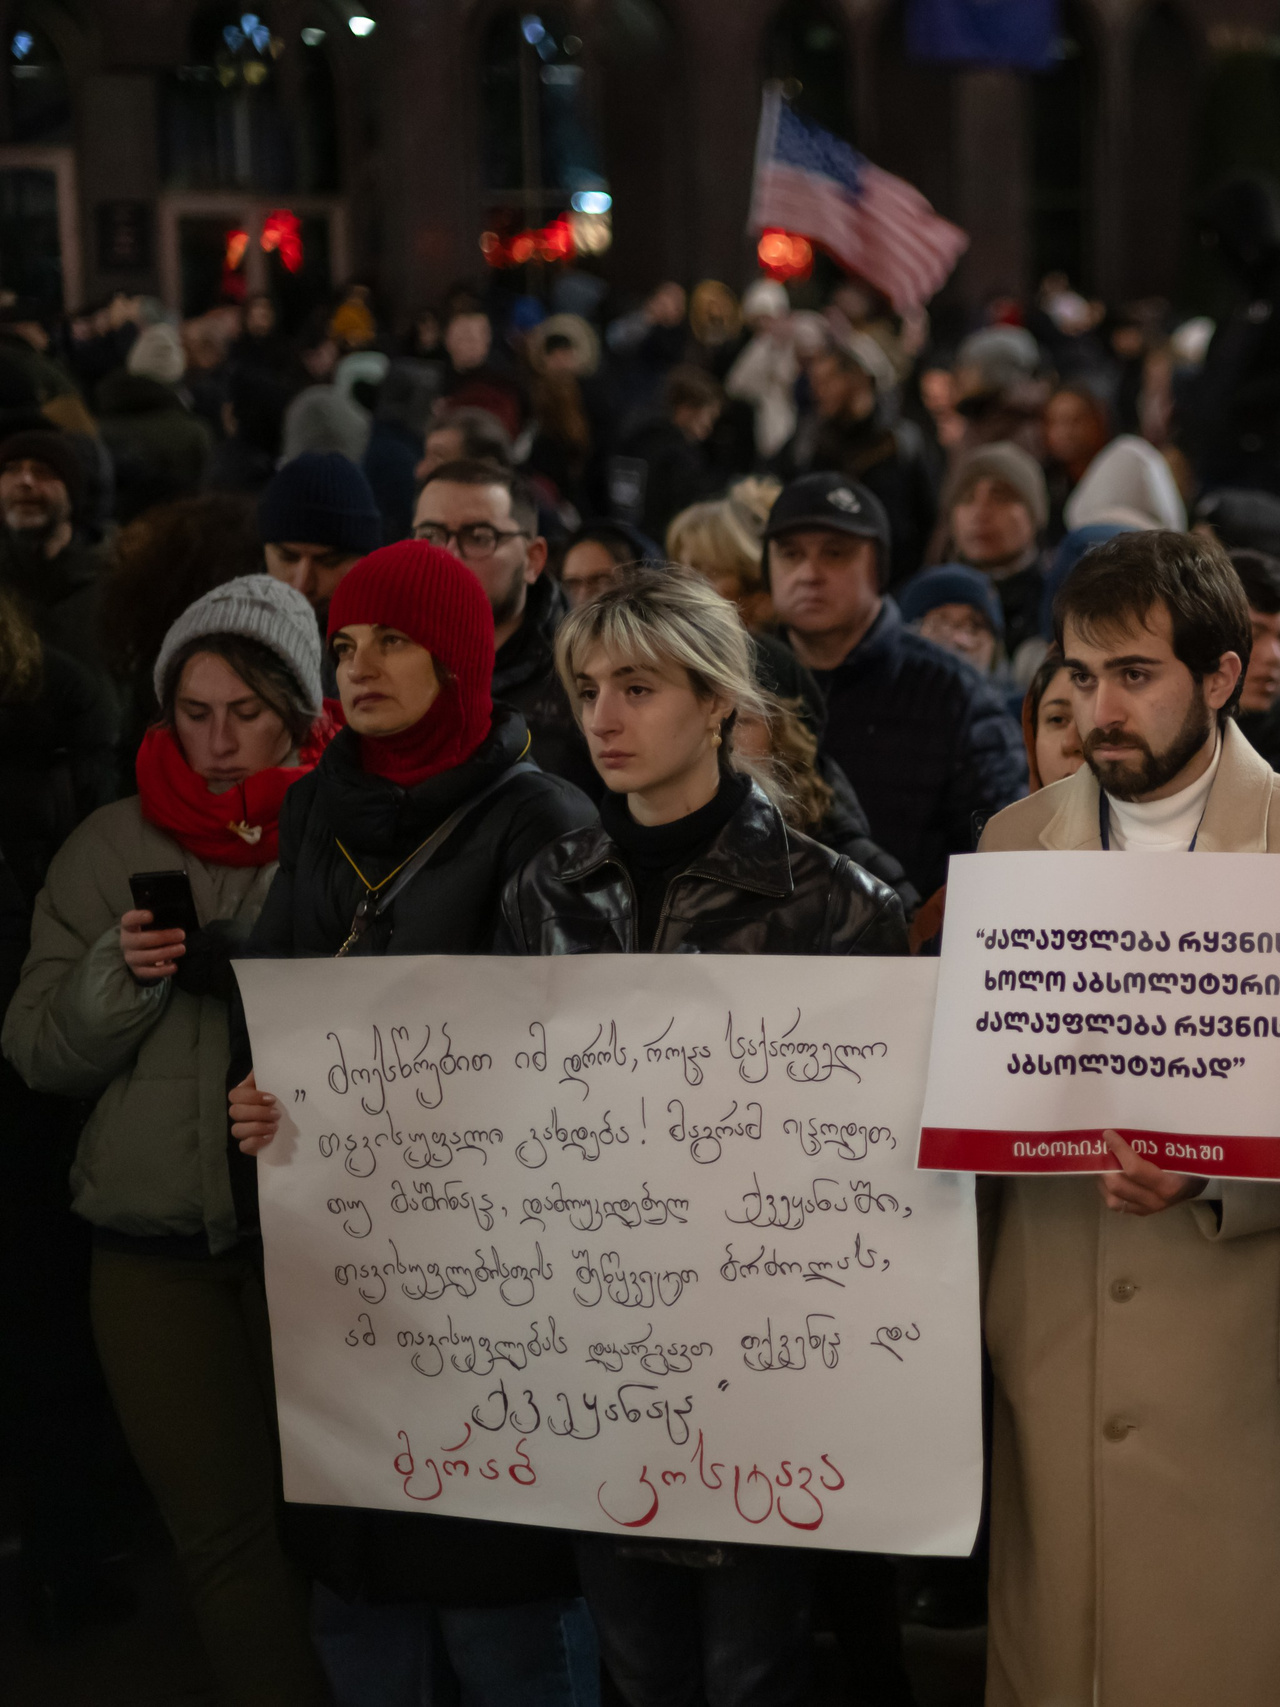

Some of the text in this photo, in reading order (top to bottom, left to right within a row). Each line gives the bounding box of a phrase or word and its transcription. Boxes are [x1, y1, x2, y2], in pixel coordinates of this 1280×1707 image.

[976, 928, 1171, 952] “ძალაუფლება
[984, 970, 1280, 995] ხოლო აბსოლუტური
[976, 1011, 1167, 1036] ძალაუფლება
[515, 1022, 547, 1072] იმ
[1007, 1053, 1245, 1079] აბსოლუტურად”
[667, 1099, 762, 1164] მაგრამ
[1014, 1140, 1223, 1160] ისტორიკთა მარში
[327, 1198, 372, 1238] თუ
[345, 1313, 375, 1347] ამ
[870, 1323, 920, 1362] და
[394, 1422, 845, 1531] მერაბ კოსტავა
